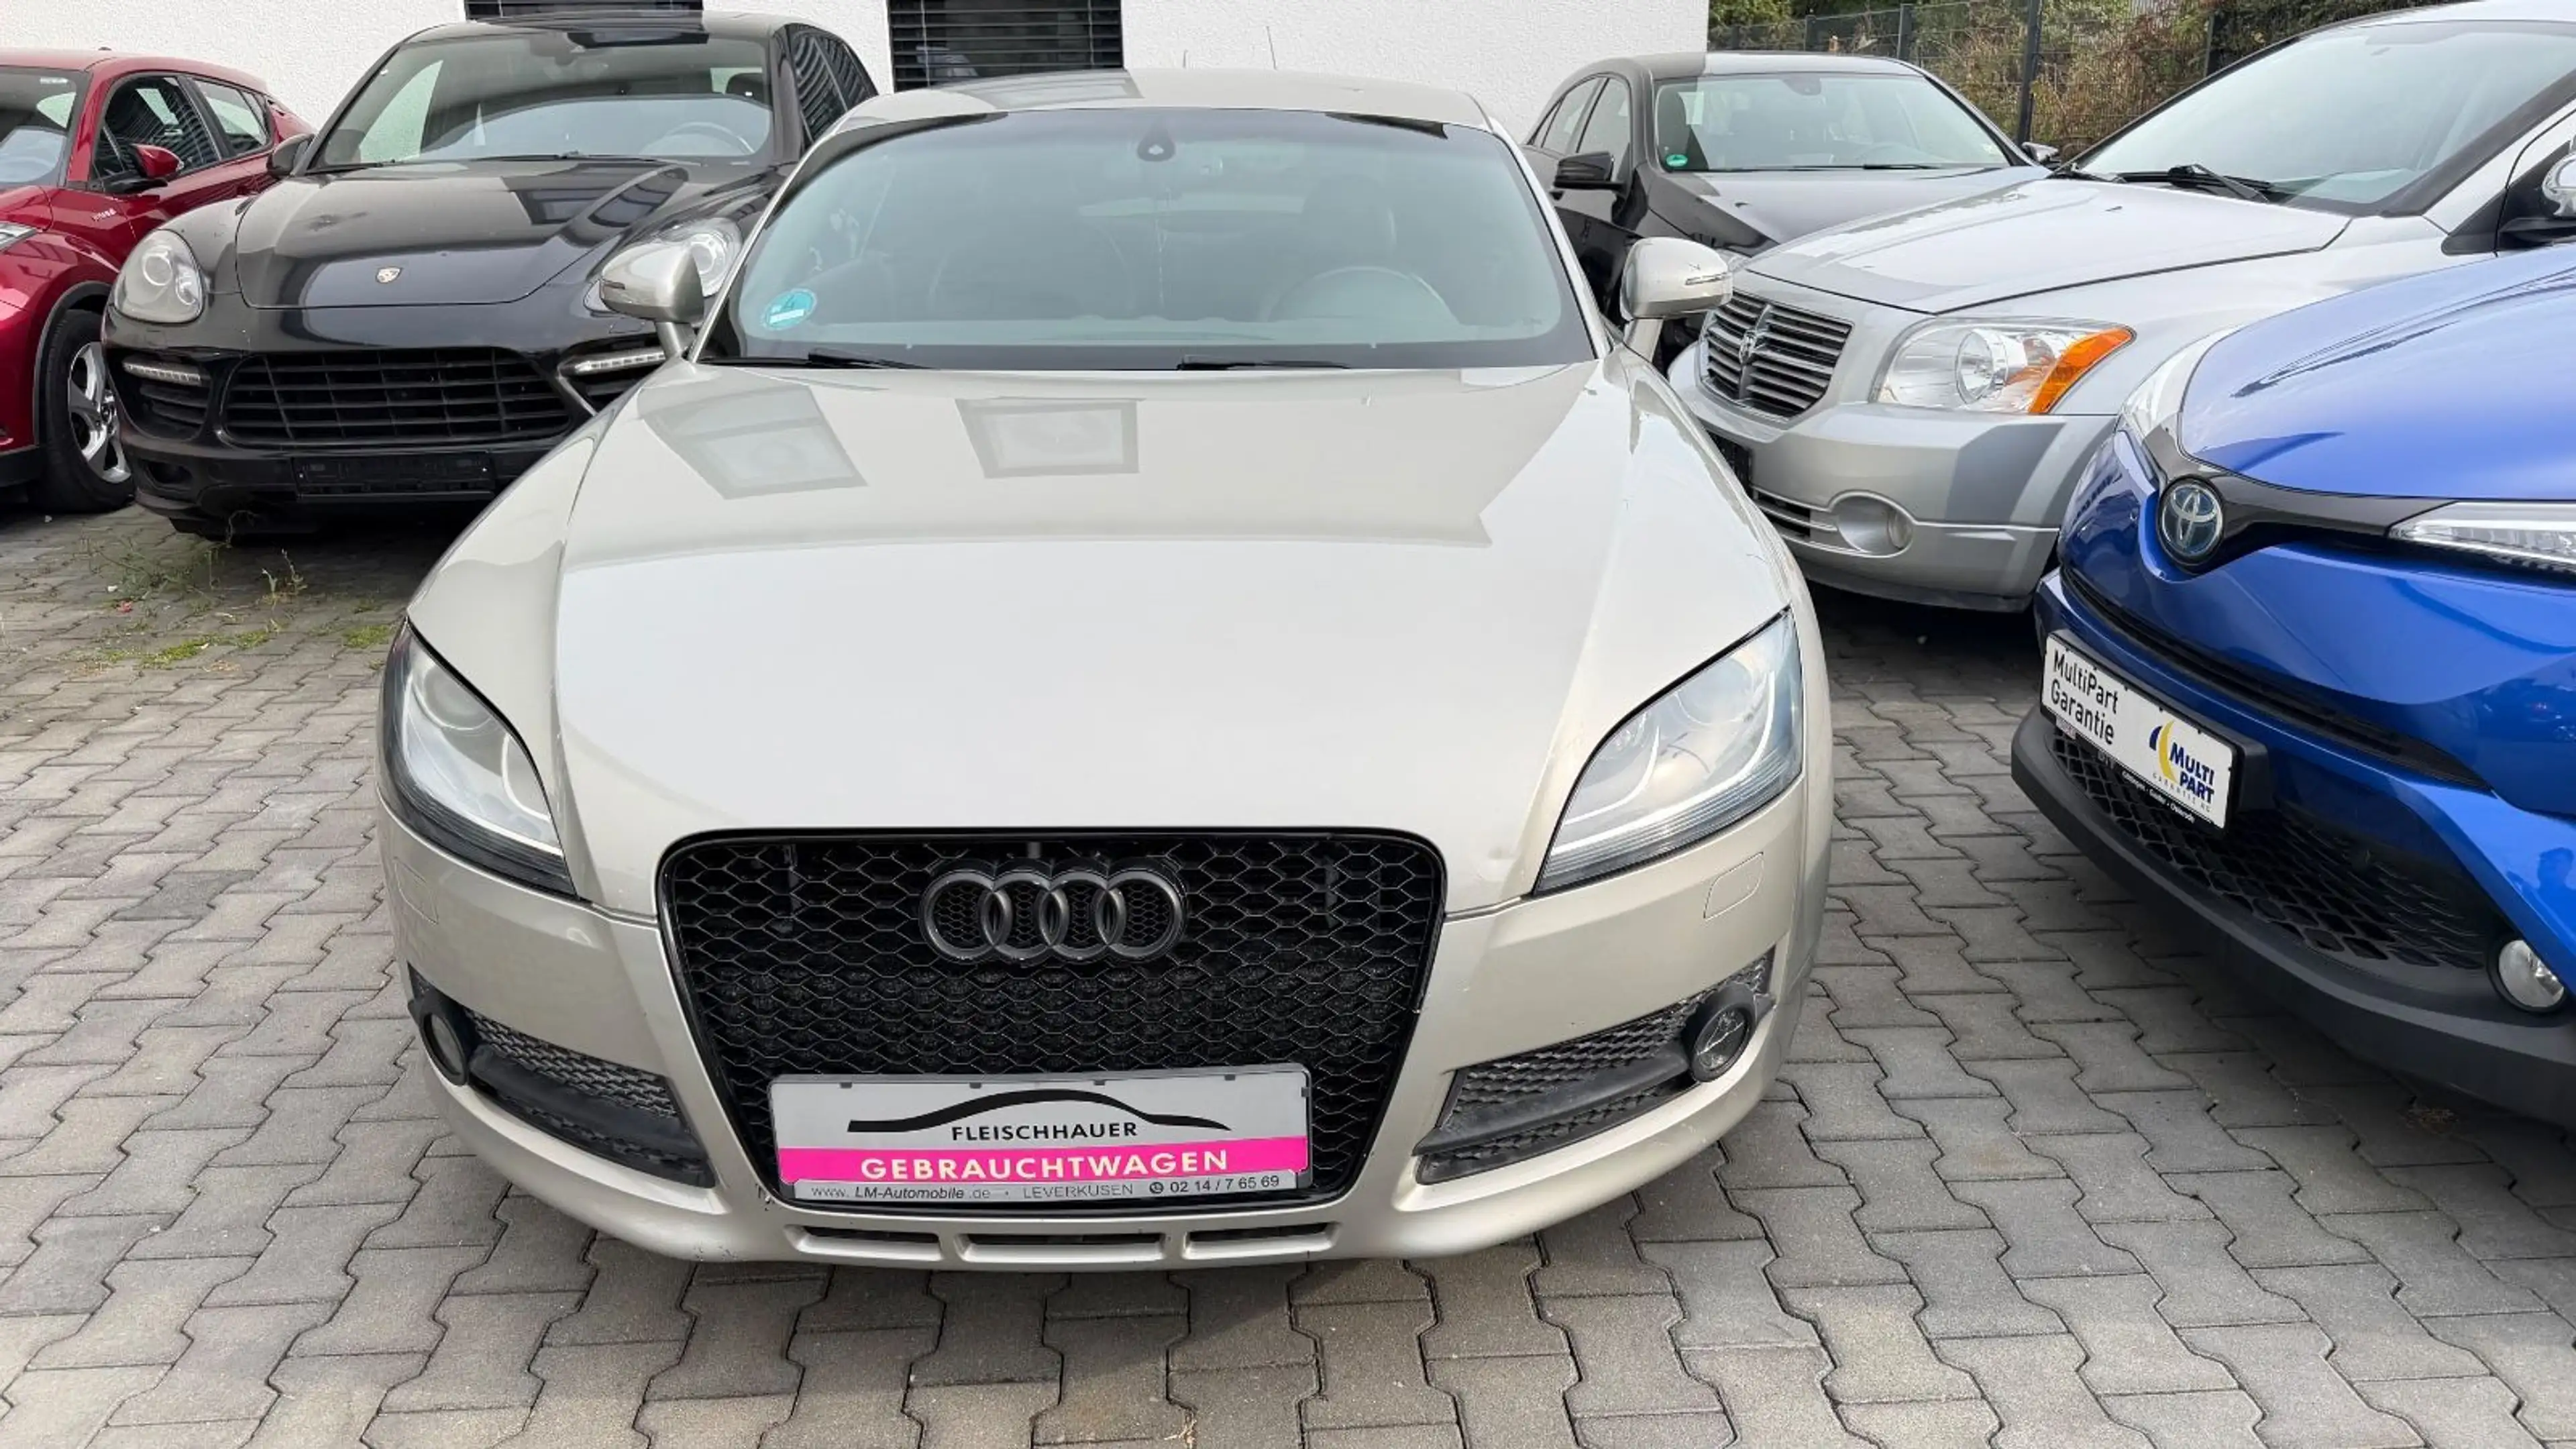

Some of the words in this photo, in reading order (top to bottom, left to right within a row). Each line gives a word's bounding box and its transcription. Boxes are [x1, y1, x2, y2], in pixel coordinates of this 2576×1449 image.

[2053, 649, 2118, 714] MultiPart
[2051, 678, 2115, 745] Garantie
[2169, 742, 2215, 786] MULTI
[2180, 771, 2215, 804] PART
[952, 1122, 1138, 1141] FLEISCHHAUER
[860, 1149, 1228, 1180] GEBRAUCHTWAGEN
[1023, 1183, 1134, 1199] LEVERKUSEN
[1170, 1181, 1189, 1193] 02
[1195, 1179, 1211, 1191] 14
[1225, 1178, 1234, 1190] 7
[1238, 1177, 1256, 1189] 65
[1260, 1175, 1279, 1187] 69
